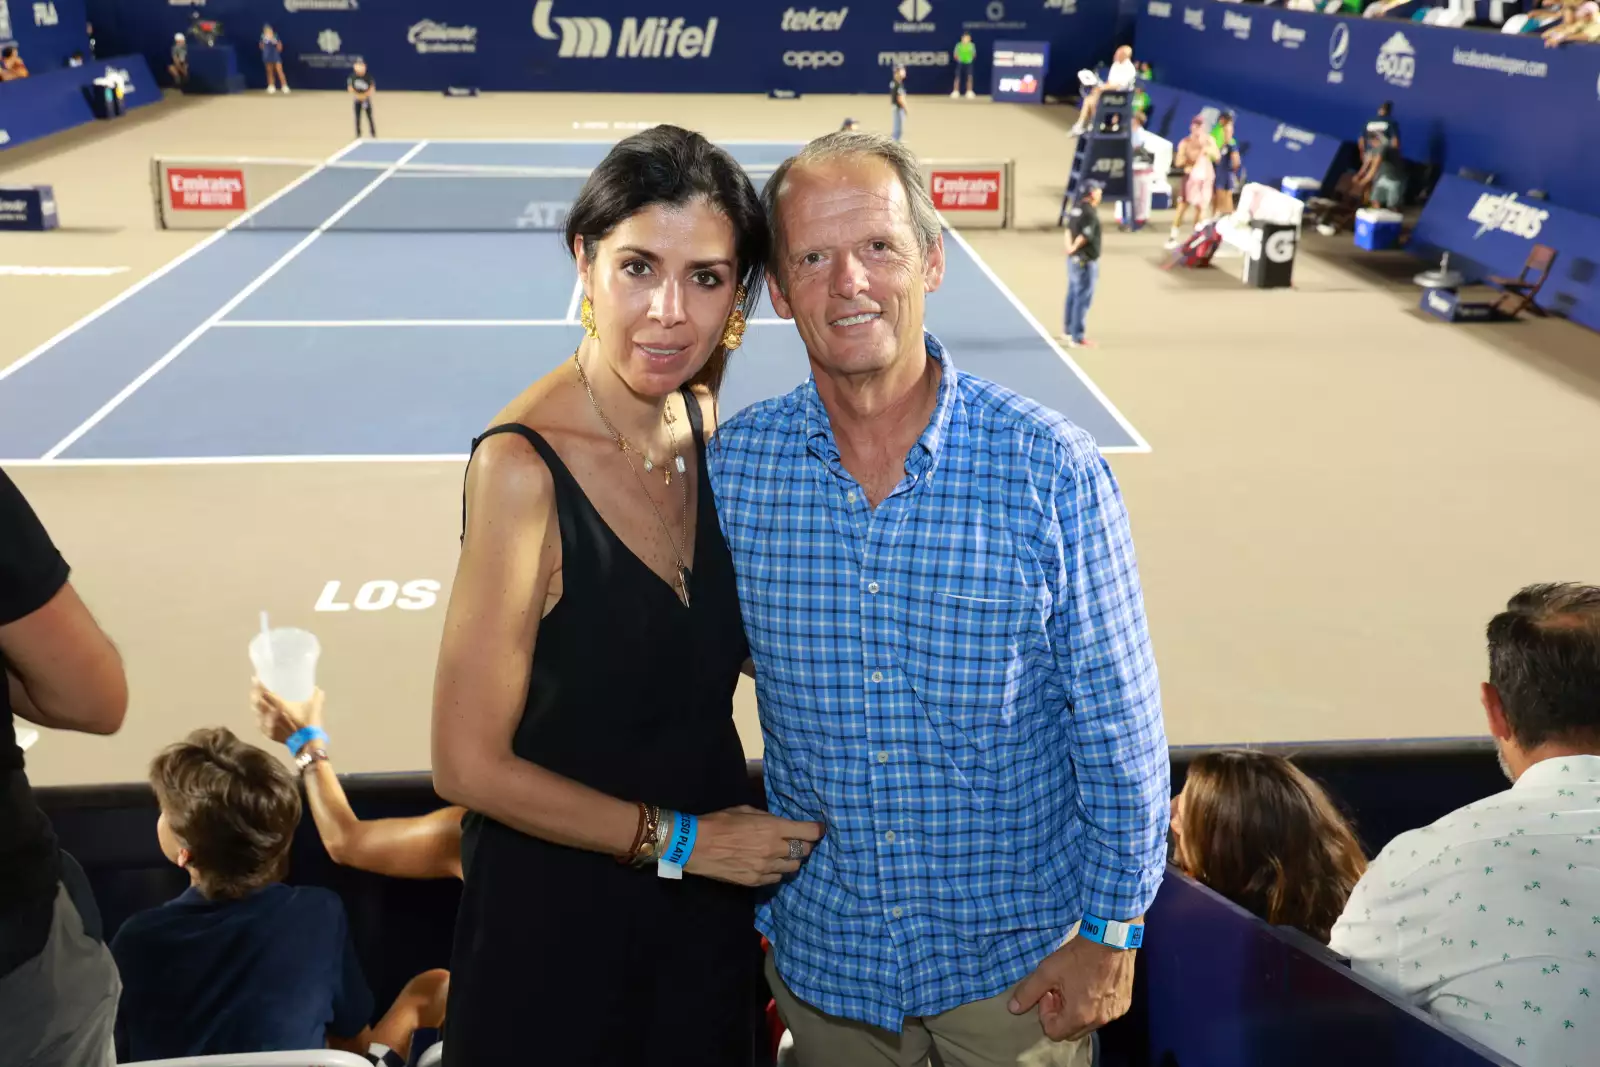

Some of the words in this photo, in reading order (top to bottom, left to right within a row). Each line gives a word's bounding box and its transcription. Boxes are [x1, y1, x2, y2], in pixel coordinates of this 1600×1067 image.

[781, 7, 849, 31] telcel
[616, 17, 719, 59] Mifel
[782, 51, 844, 69] oppo
[171, 175, 242, 192] Emirates
[933, 176, 997, 192] Emirates
[1265, 230, 1296, 264] G
[313, 578, 441, 612] LOS
